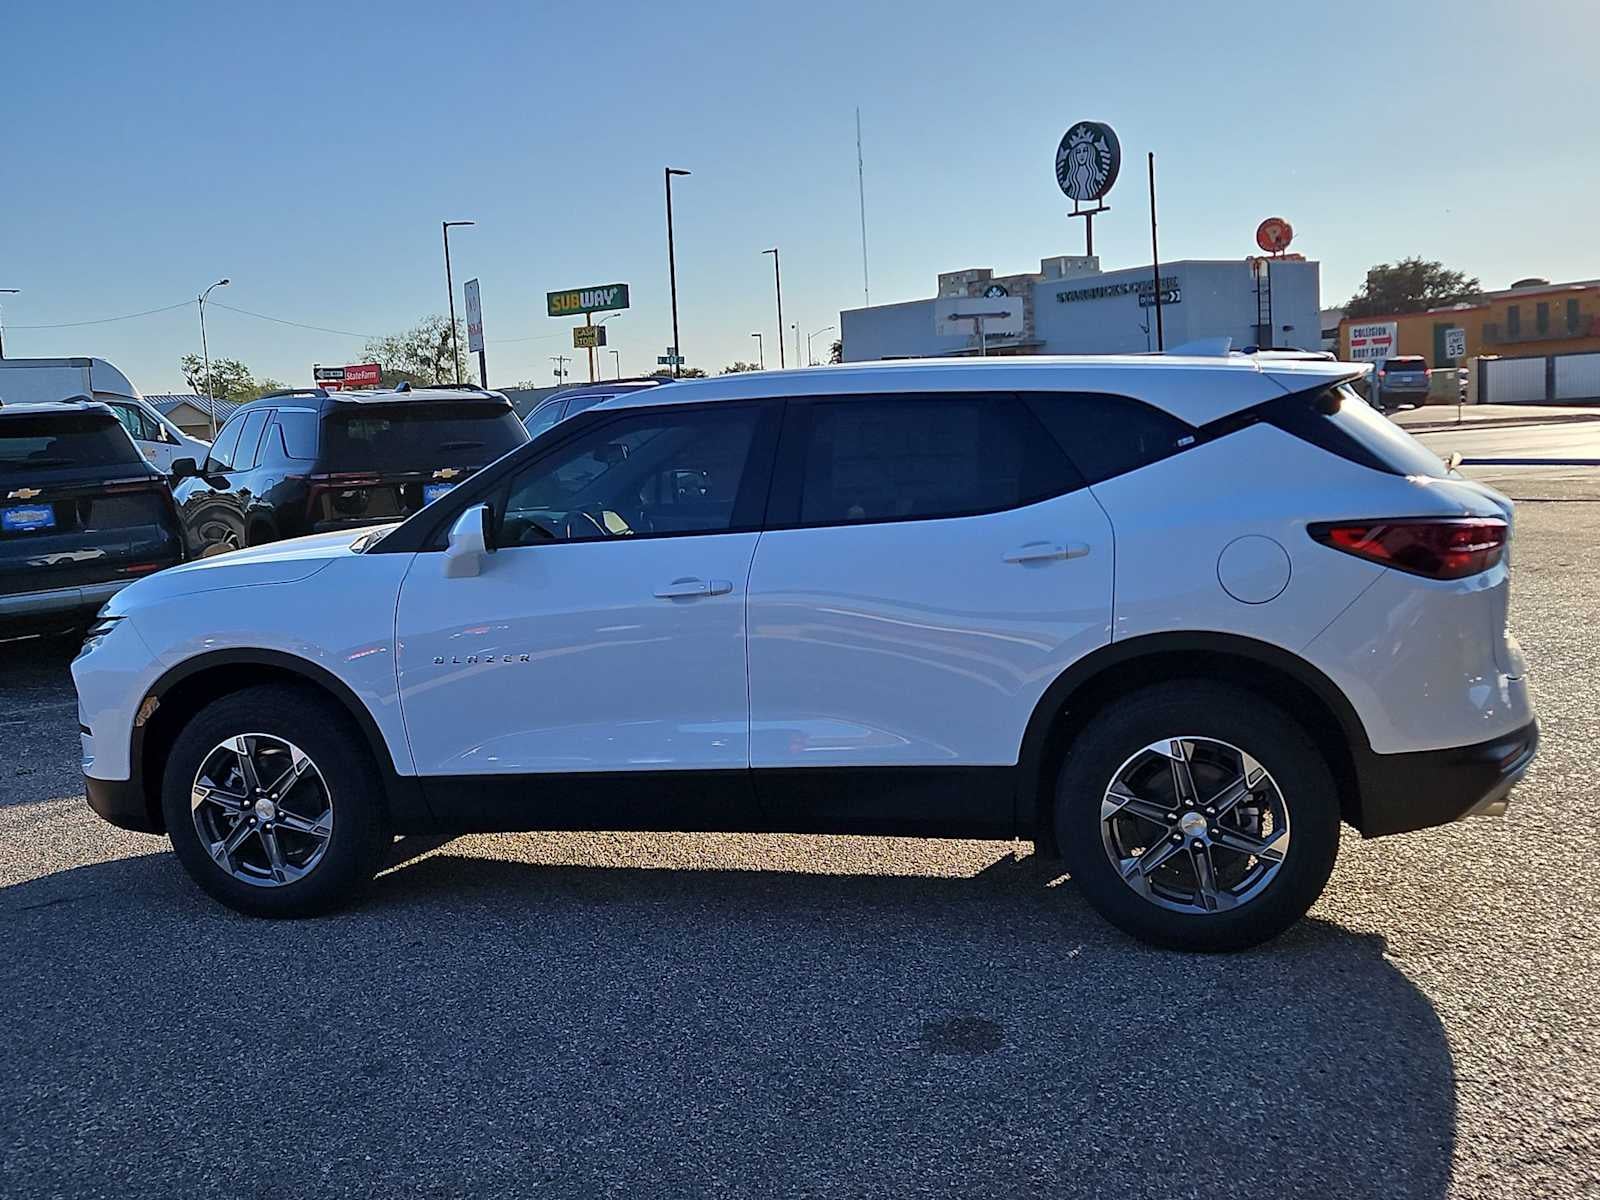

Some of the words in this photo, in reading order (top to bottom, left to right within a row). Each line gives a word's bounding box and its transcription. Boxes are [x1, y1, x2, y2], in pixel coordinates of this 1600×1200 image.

[552, 288, 614, 313] SUBWAY
[1449, 344, 1464, 356] 35
[432, 653, 530, 665] BLAZER
